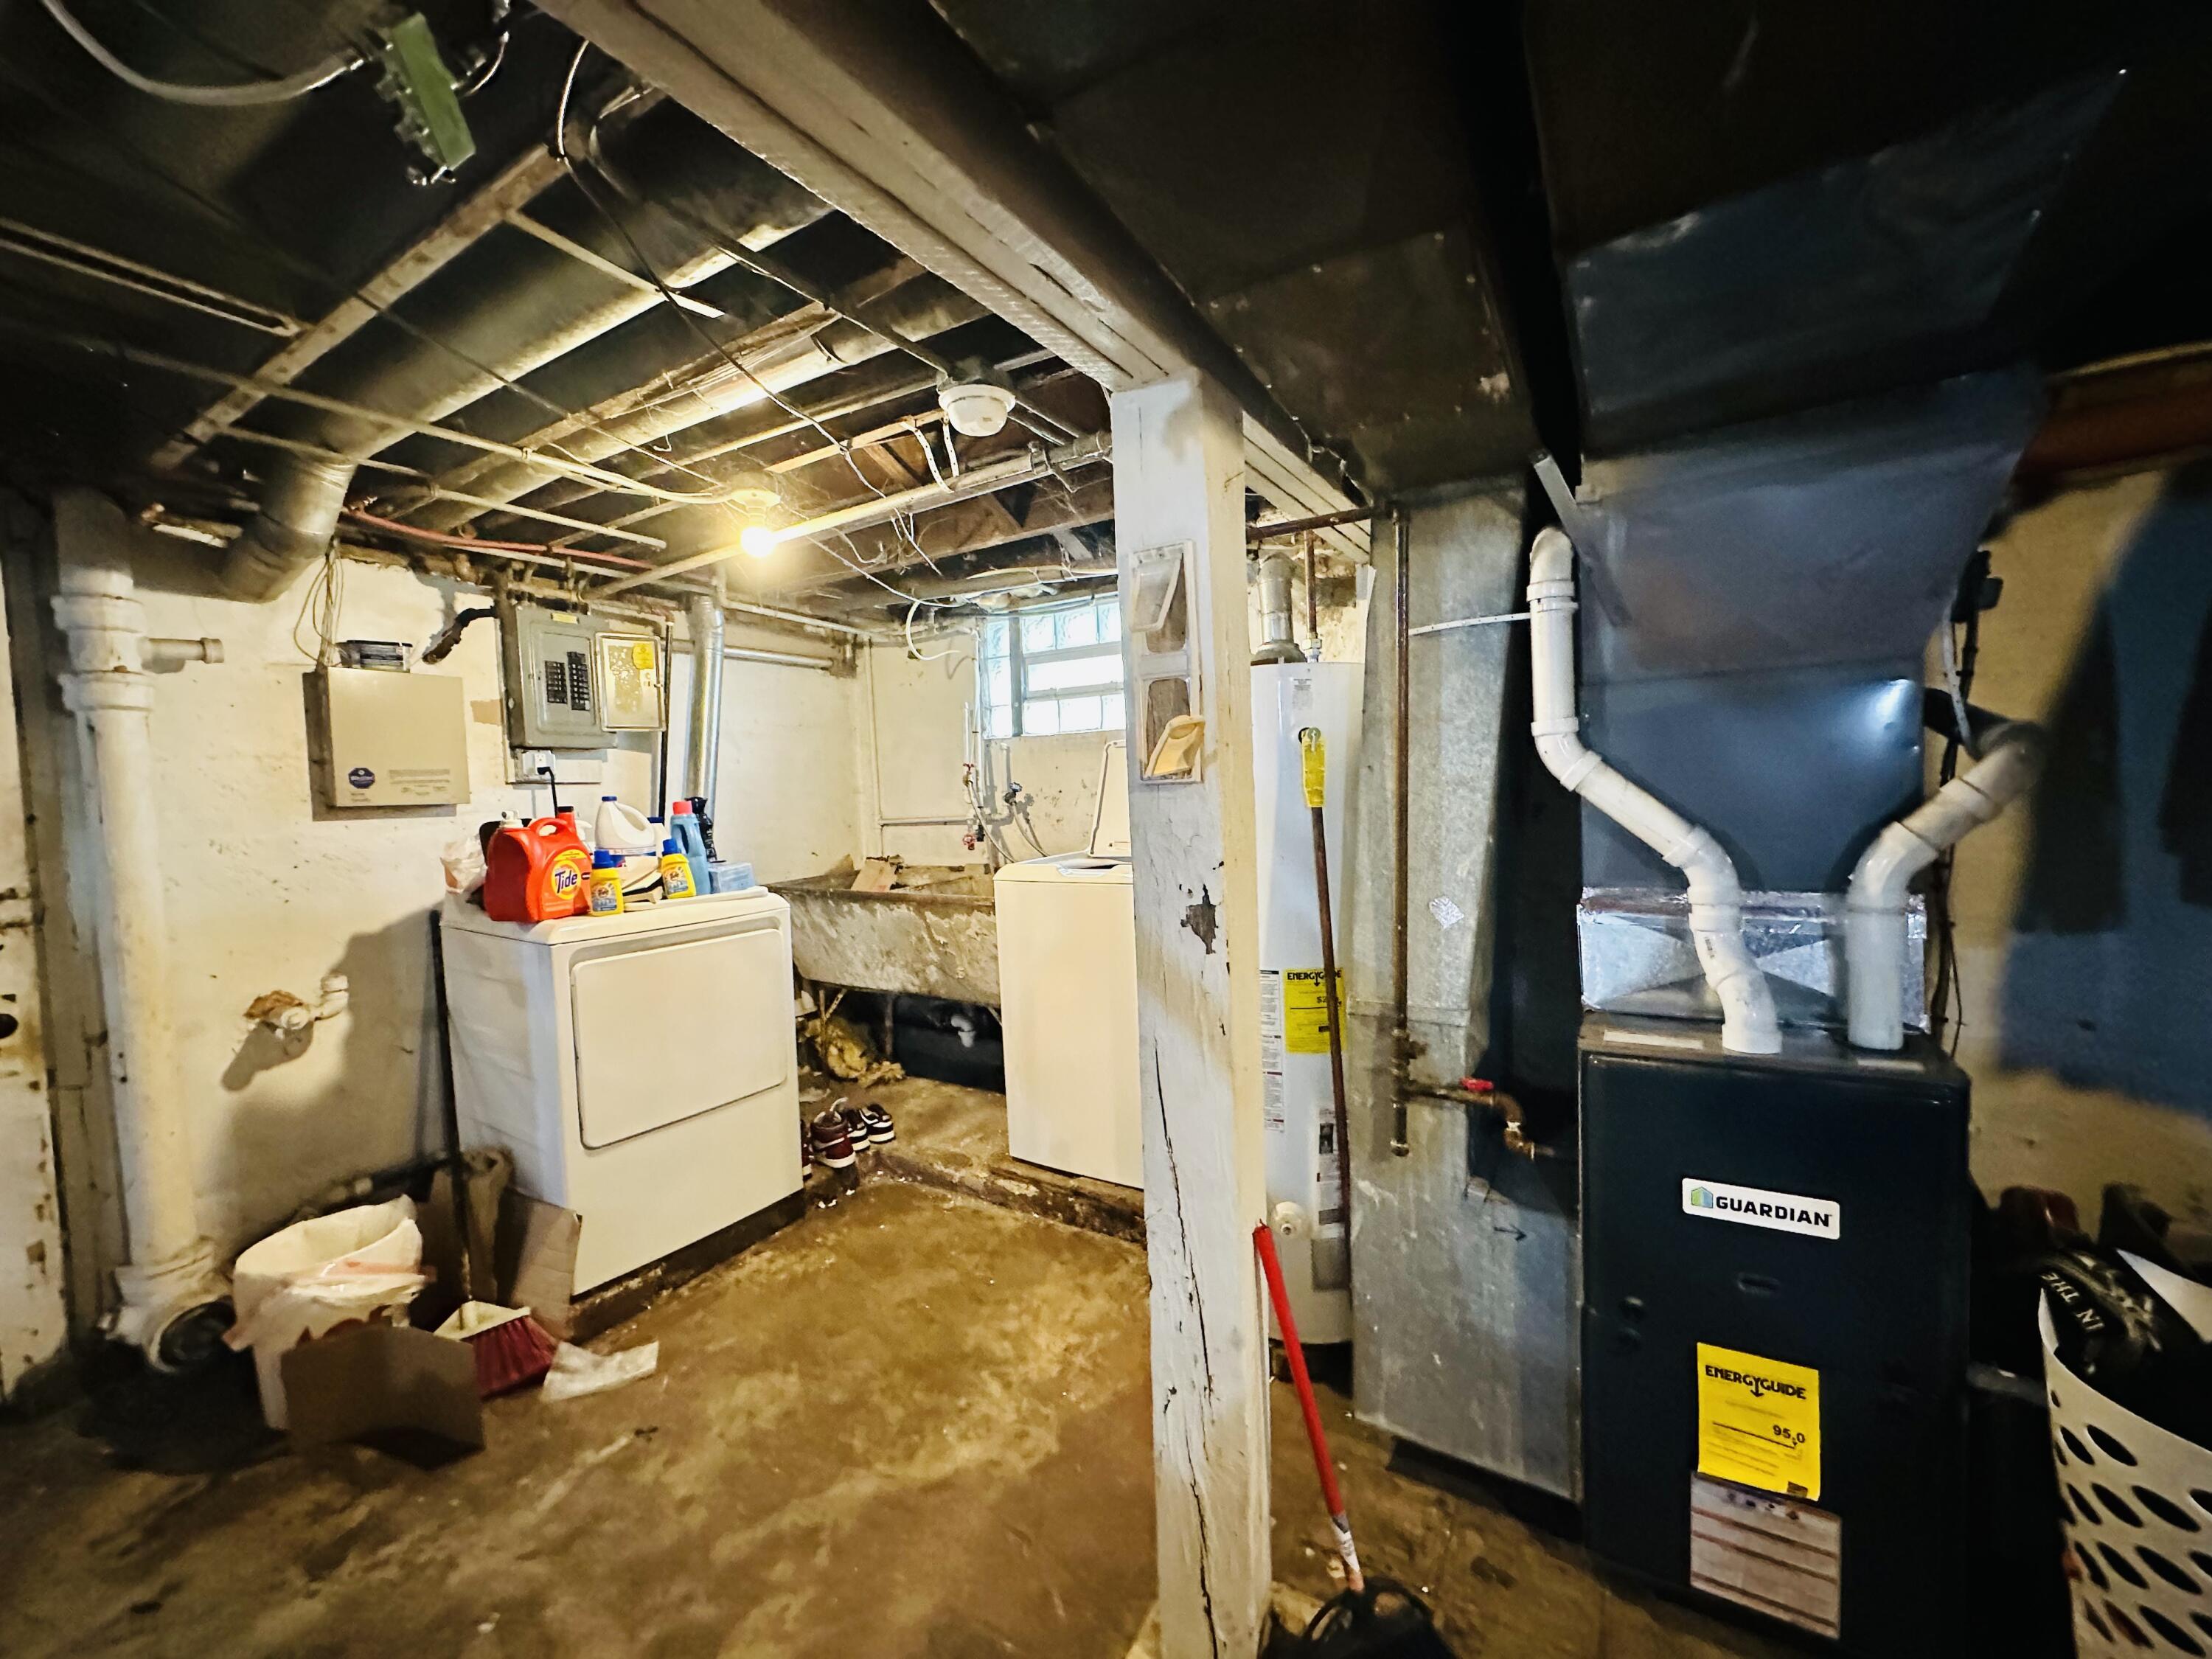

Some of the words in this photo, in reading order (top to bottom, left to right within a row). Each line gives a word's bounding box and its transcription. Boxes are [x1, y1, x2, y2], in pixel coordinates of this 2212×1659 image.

[554, 870, 578, 894] Tide
[1716, 1195, 1830, 1228] GUARDIAN
[2040, 1272, 2080, 1304] THE
[2076, 1308, 2106, 1332] IN
[1705, 1364, 1806, 1400] ENERGYGUIDE
[1772, 1424, 1806, 1444] 95.0
